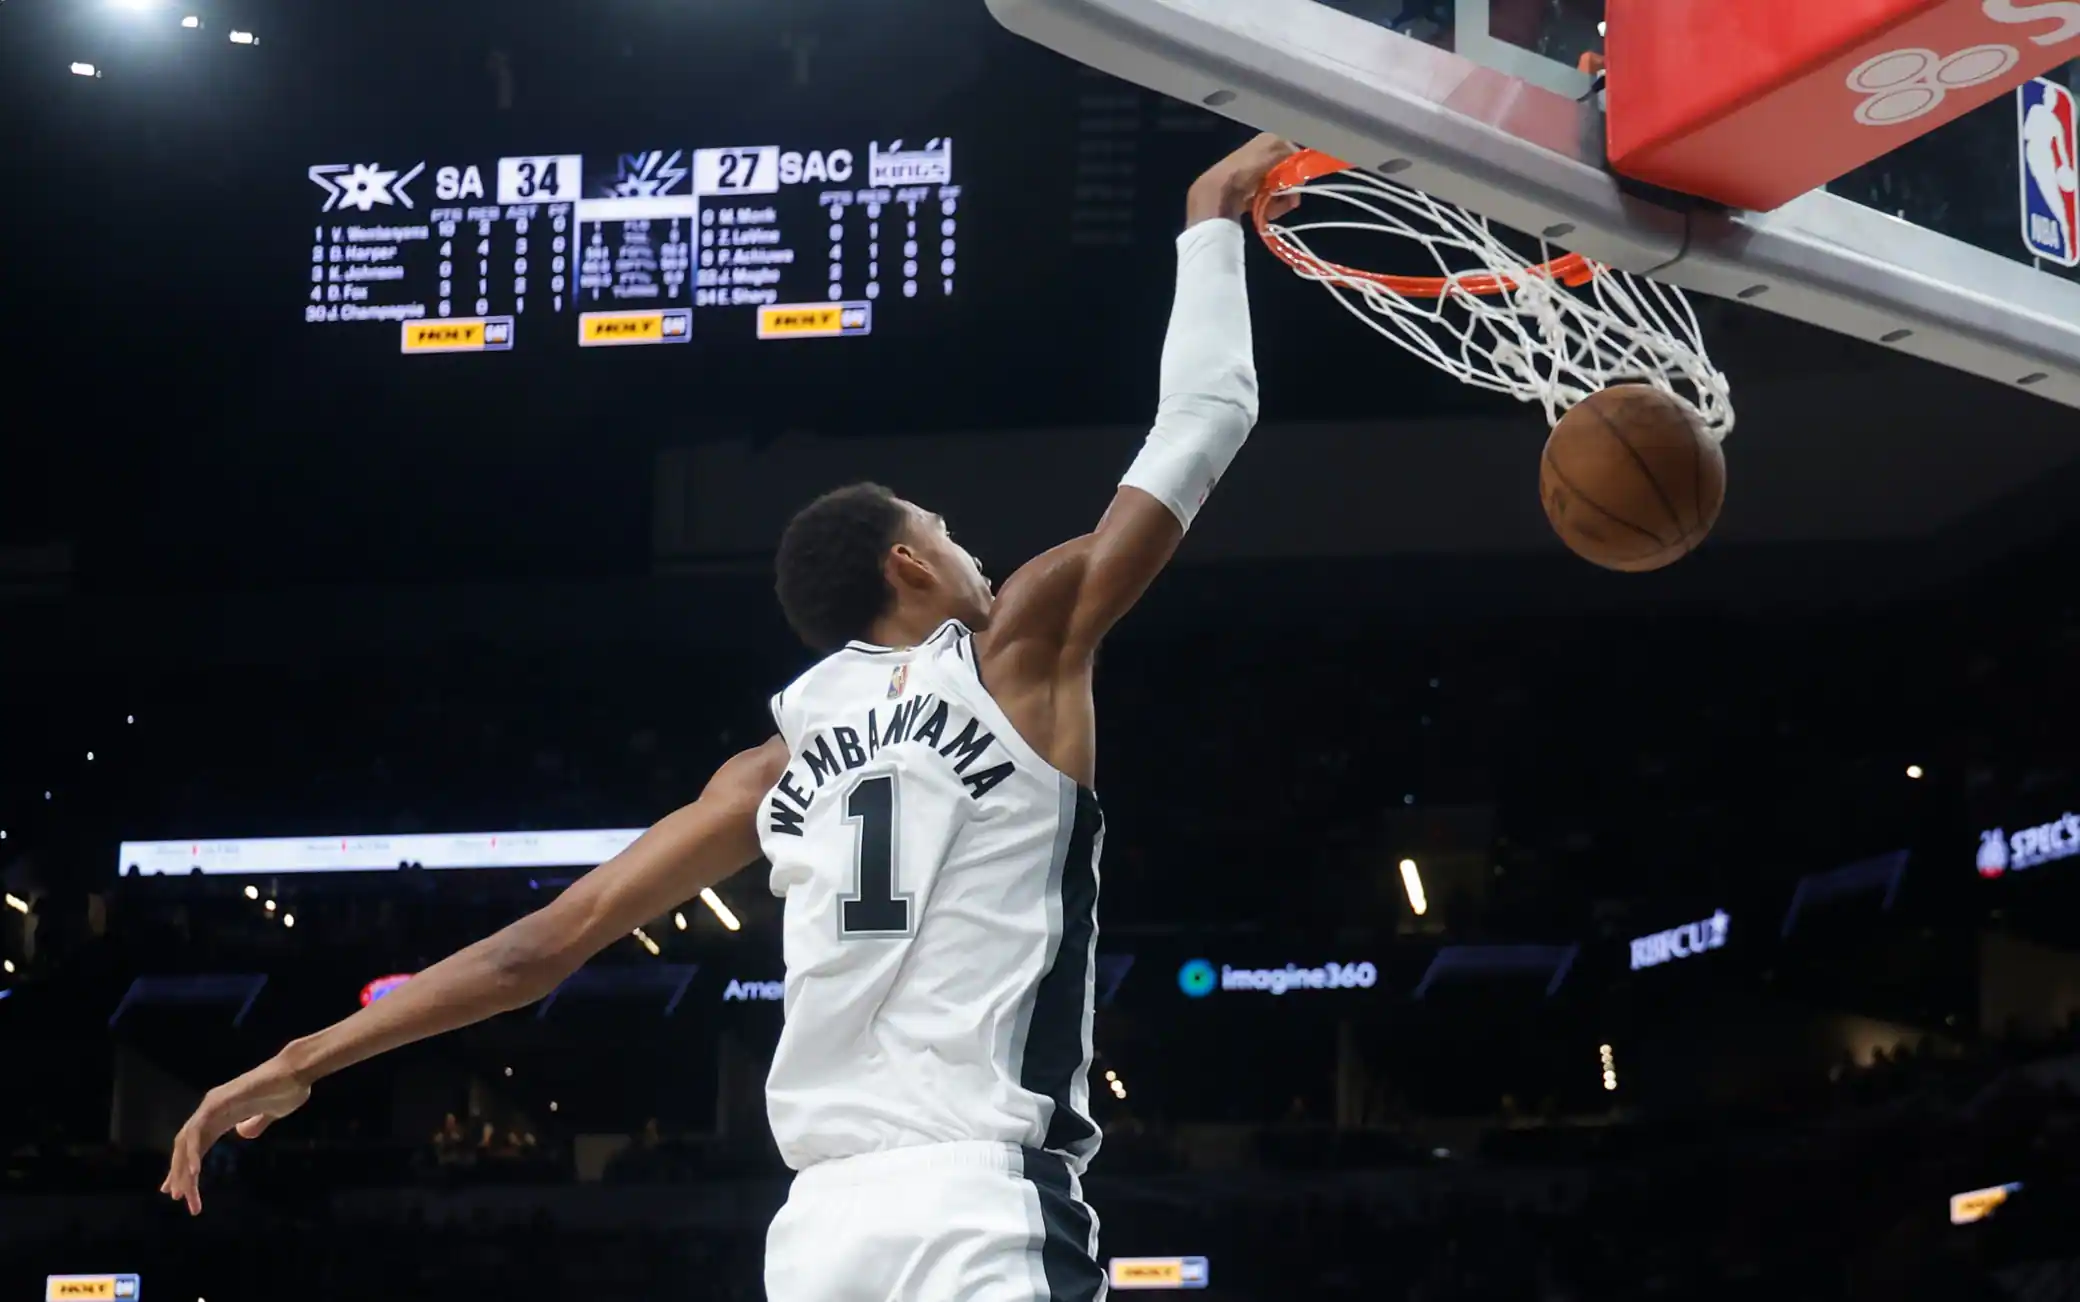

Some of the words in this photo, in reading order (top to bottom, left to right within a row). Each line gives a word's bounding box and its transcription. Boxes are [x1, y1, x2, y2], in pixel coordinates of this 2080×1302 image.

[436, 165, 485, 200] SA
[517, 162, 559, 197] 34
[718, 153, 760, 188] 27
[779, 149, 853, 184] SAC
[2031, 212, 2061, 249] NBA
[770, 693, 1016, 838] WEMBANYAMA
[837, 768, 914, 940] 1
[723, 979, 785, 1002] Ame
[1221, 962, 1377, 995] imagine360
